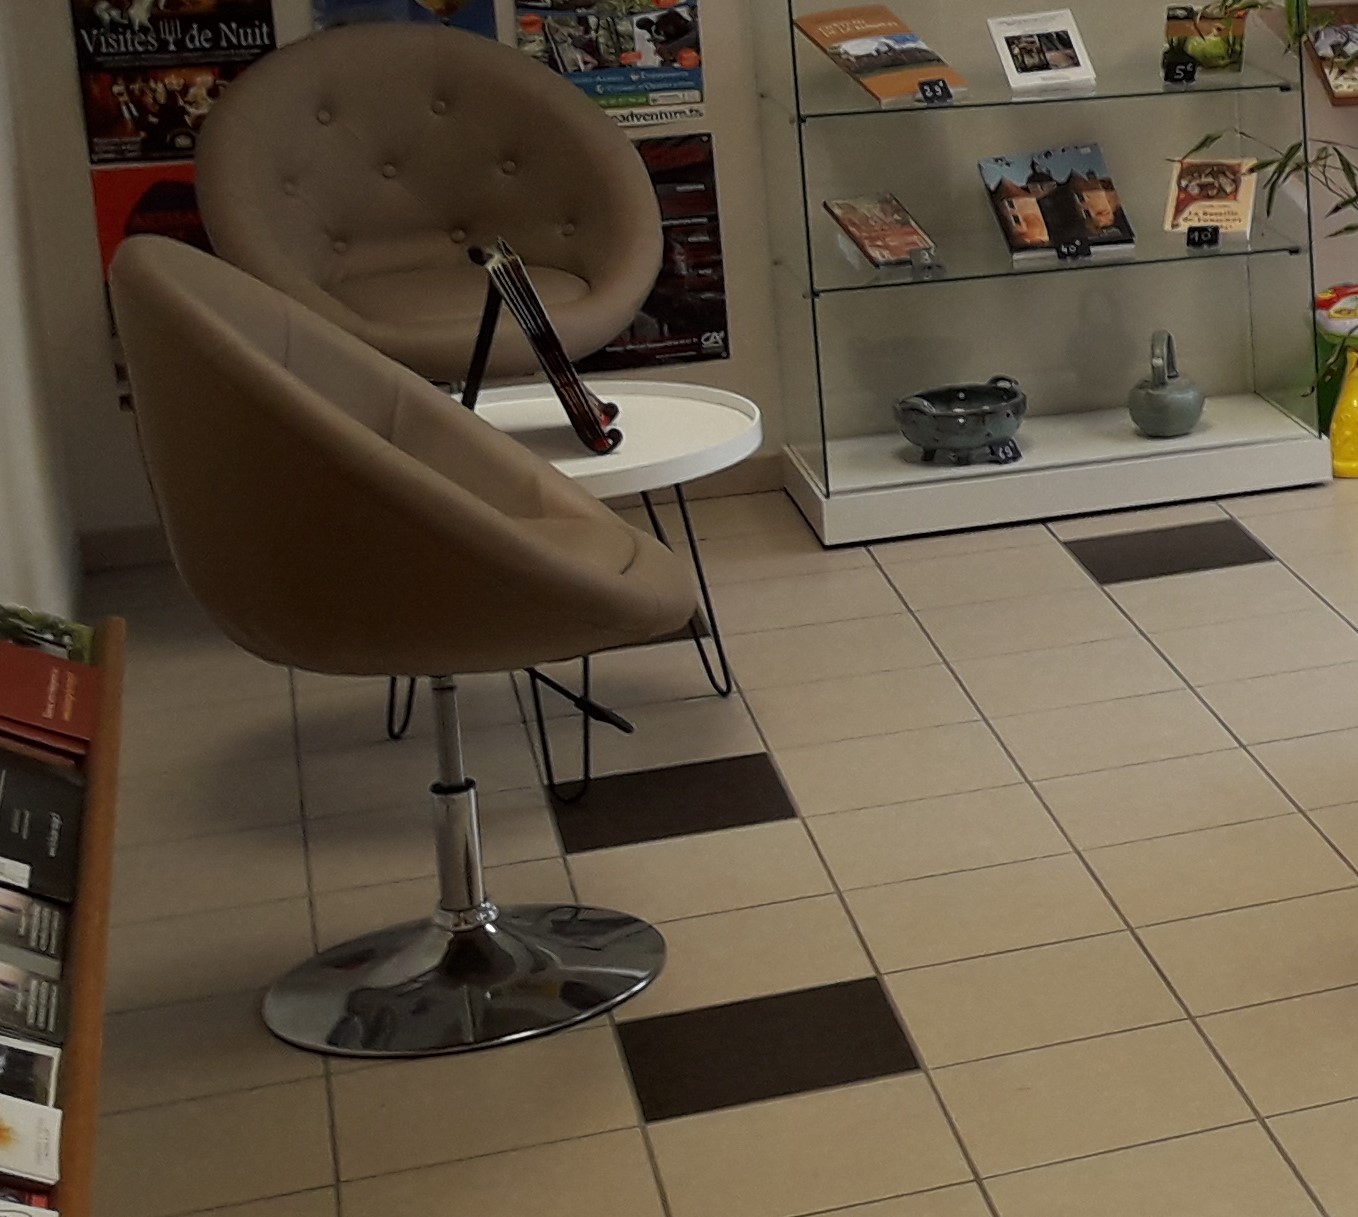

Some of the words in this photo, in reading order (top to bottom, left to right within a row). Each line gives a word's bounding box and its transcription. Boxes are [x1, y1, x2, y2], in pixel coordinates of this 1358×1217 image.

[80, 26, 159, 55] Visites
[185, 22, 214, 49] de
[217, 19, 271, 49] Nuit
